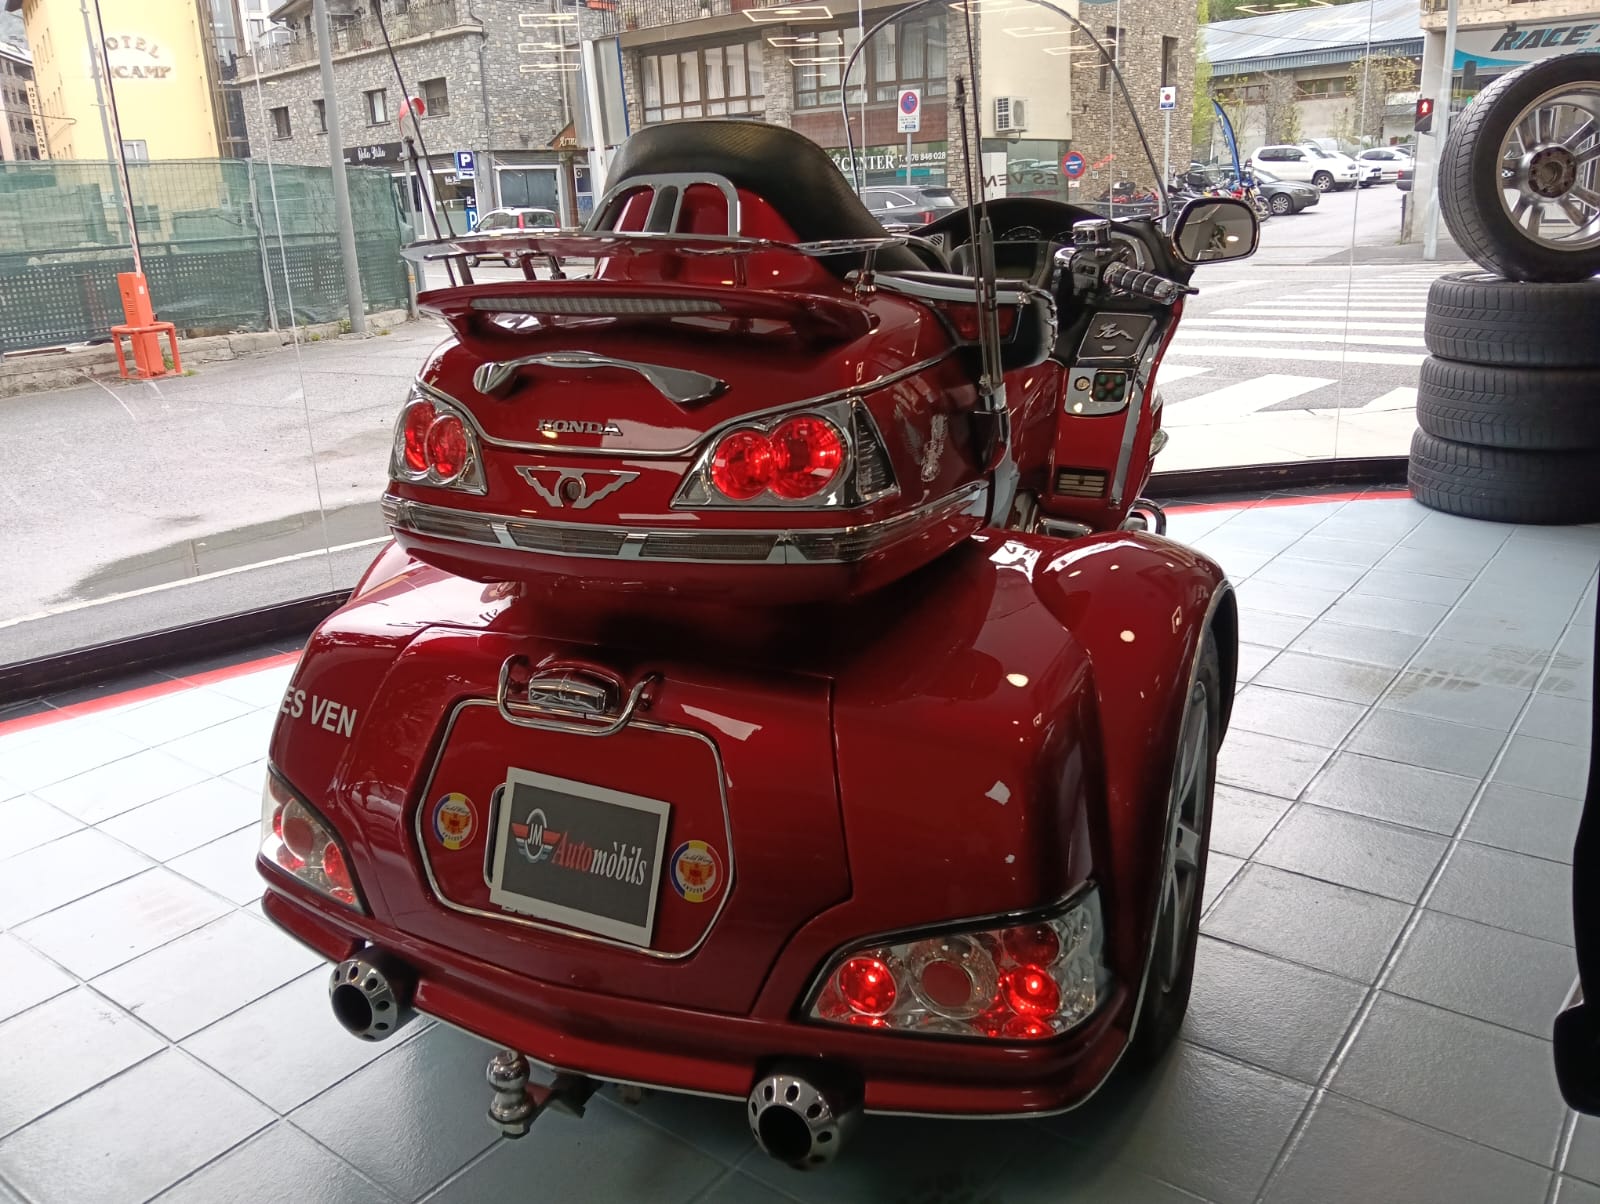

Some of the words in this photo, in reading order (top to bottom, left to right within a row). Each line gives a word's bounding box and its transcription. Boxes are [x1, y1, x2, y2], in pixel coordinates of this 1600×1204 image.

[1490, 25, 1594, 51] RACE
[28, 87, 37, 115] HOTEL
[35, 119, 46, 155] ENCAMP
[460, 153, 471, 167] P
[933, 151, 946, 160] 028
[537, 418, 623, 436] HONDA
[280, 685, 306, 718] ES
[311, 695, 358, 738] VEN
[527, 823, 543, 846] JM
[551, 832, 647, 886] Automòbils
